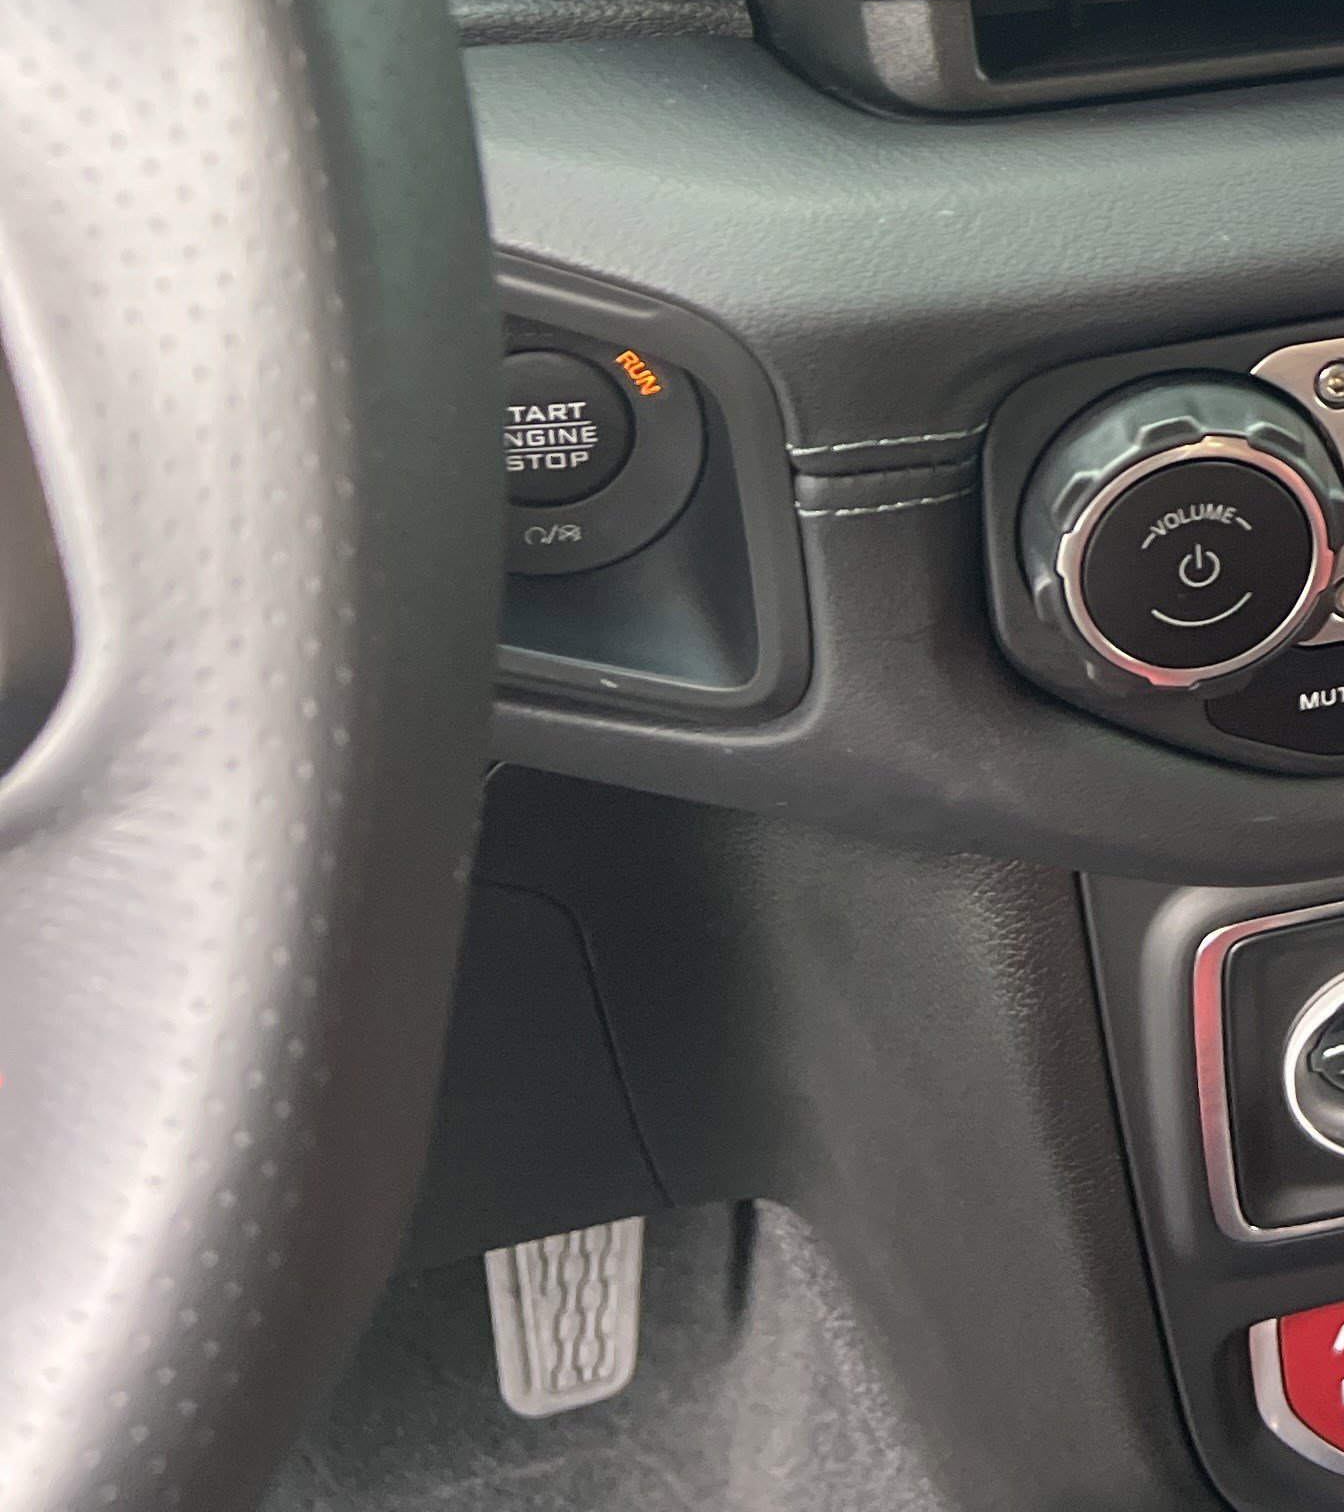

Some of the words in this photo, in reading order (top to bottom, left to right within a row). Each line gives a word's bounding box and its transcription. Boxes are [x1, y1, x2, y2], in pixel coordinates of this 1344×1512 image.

[616, 350, 661, 396] RUN
[507, 401, 587, 423] TART
[503, 425, 598, 447] NGINE
[505, 451, 589, 472] STOP
[1152, 503, 1236, 539] VOLUME
